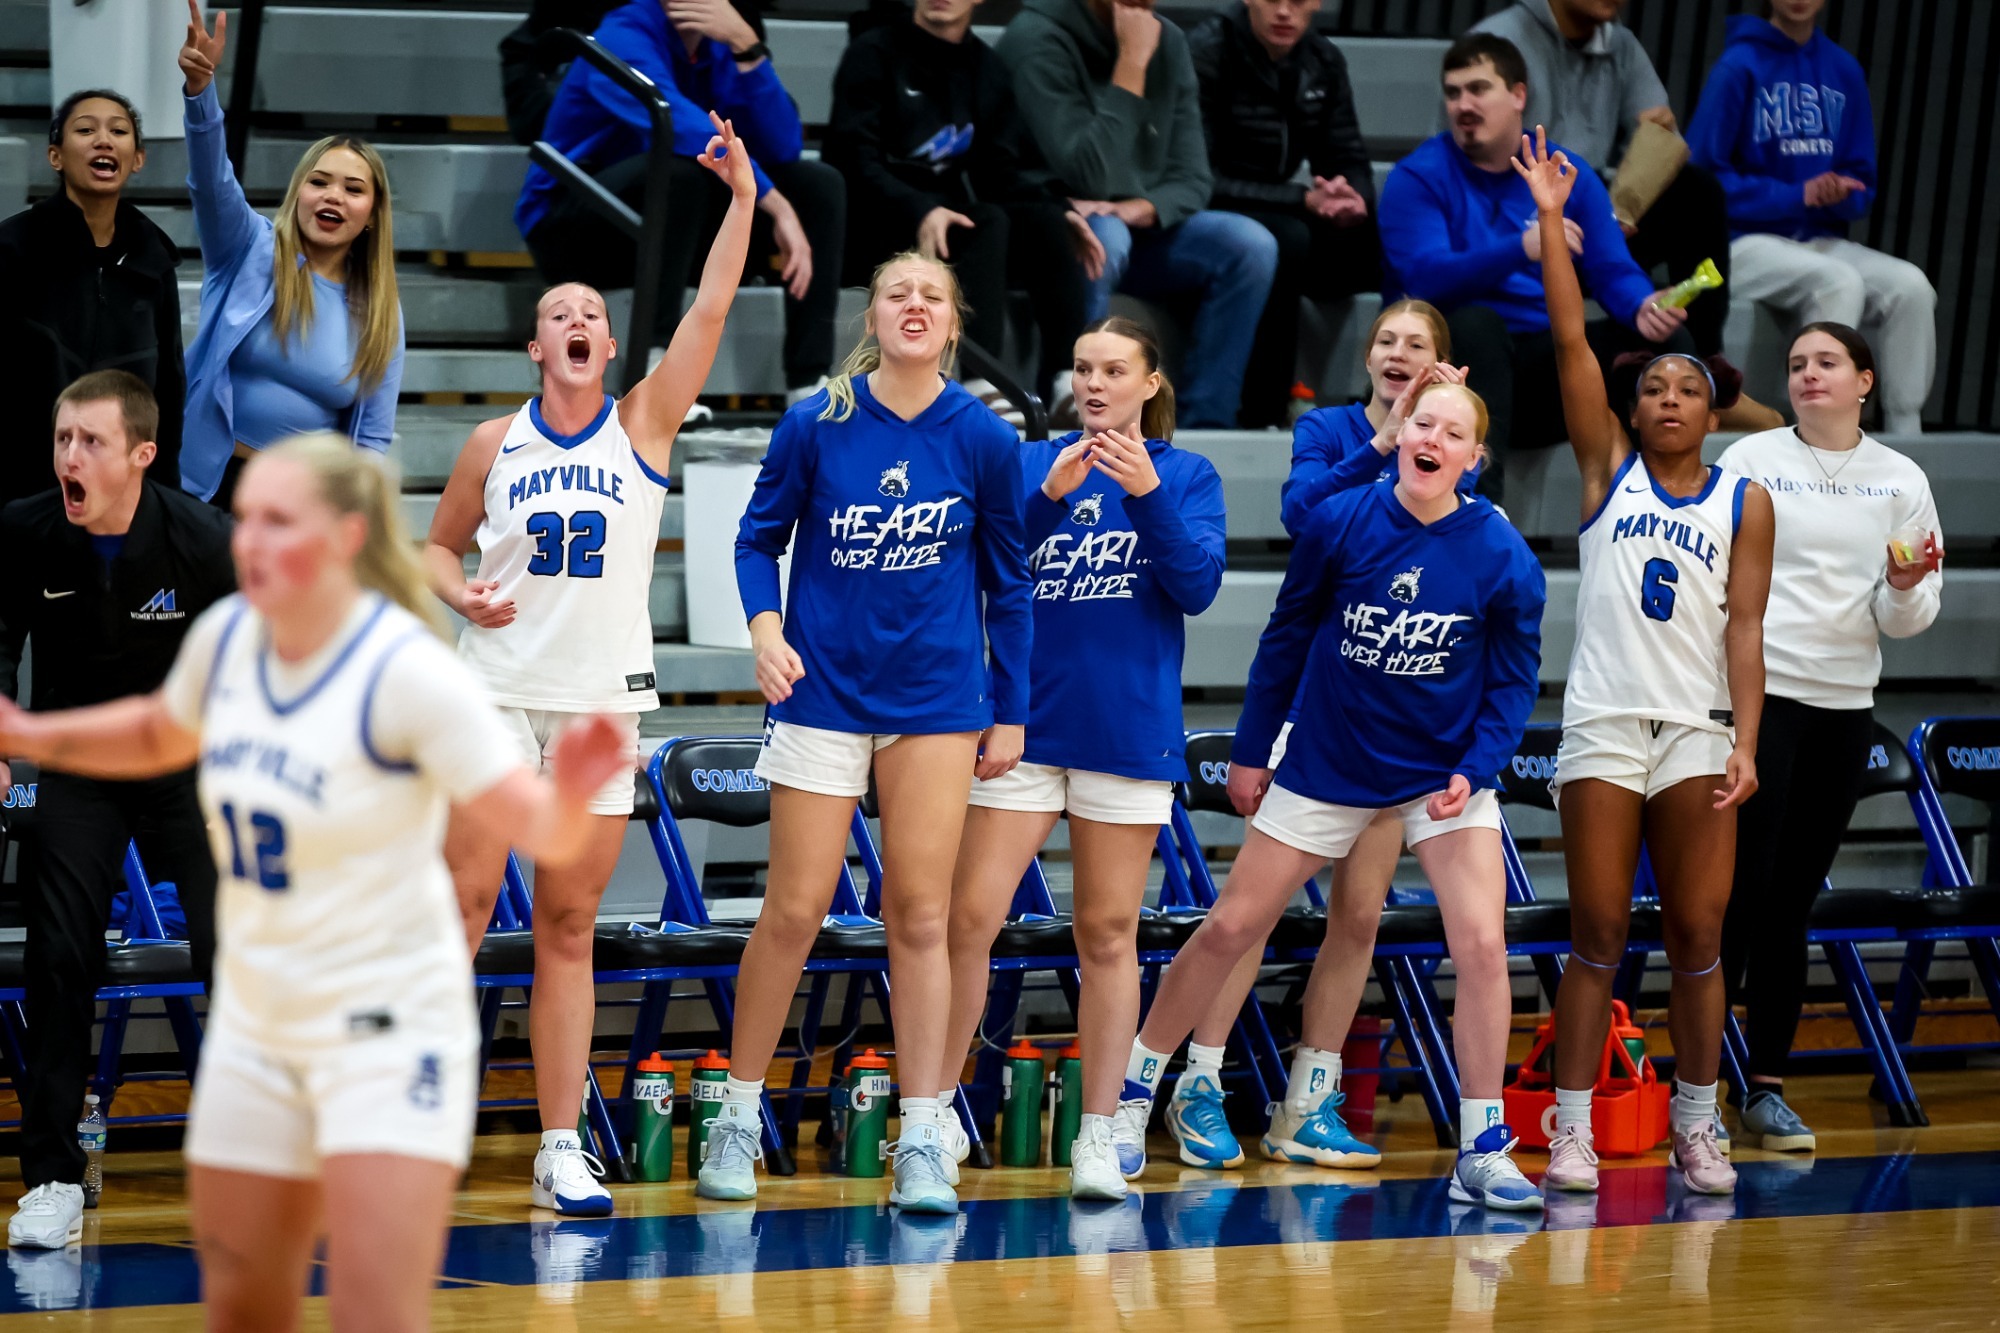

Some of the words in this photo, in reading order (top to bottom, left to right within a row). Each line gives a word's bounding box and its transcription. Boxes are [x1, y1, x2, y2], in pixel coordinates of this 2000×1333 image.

[509, 464, 624, 511] MAYVILLE
[1855, 483, 1900, 498] State
[526, 510, 607, 578] 32
[831, 547, 878, 570] OVER
[880, 541, 948, 571] HYPE
[1612, 512, 1719, 574] MAYVILLE
[1069, 572, 1138, 602] HYPE
[1641, 556, 1679, 622] 6
[1340, 638, 1381, 668] OVER
[1383, 650, 1450, 676] HYPE
[691, 768, 771, 793] COME
[220, 801, 289, 890] 12
